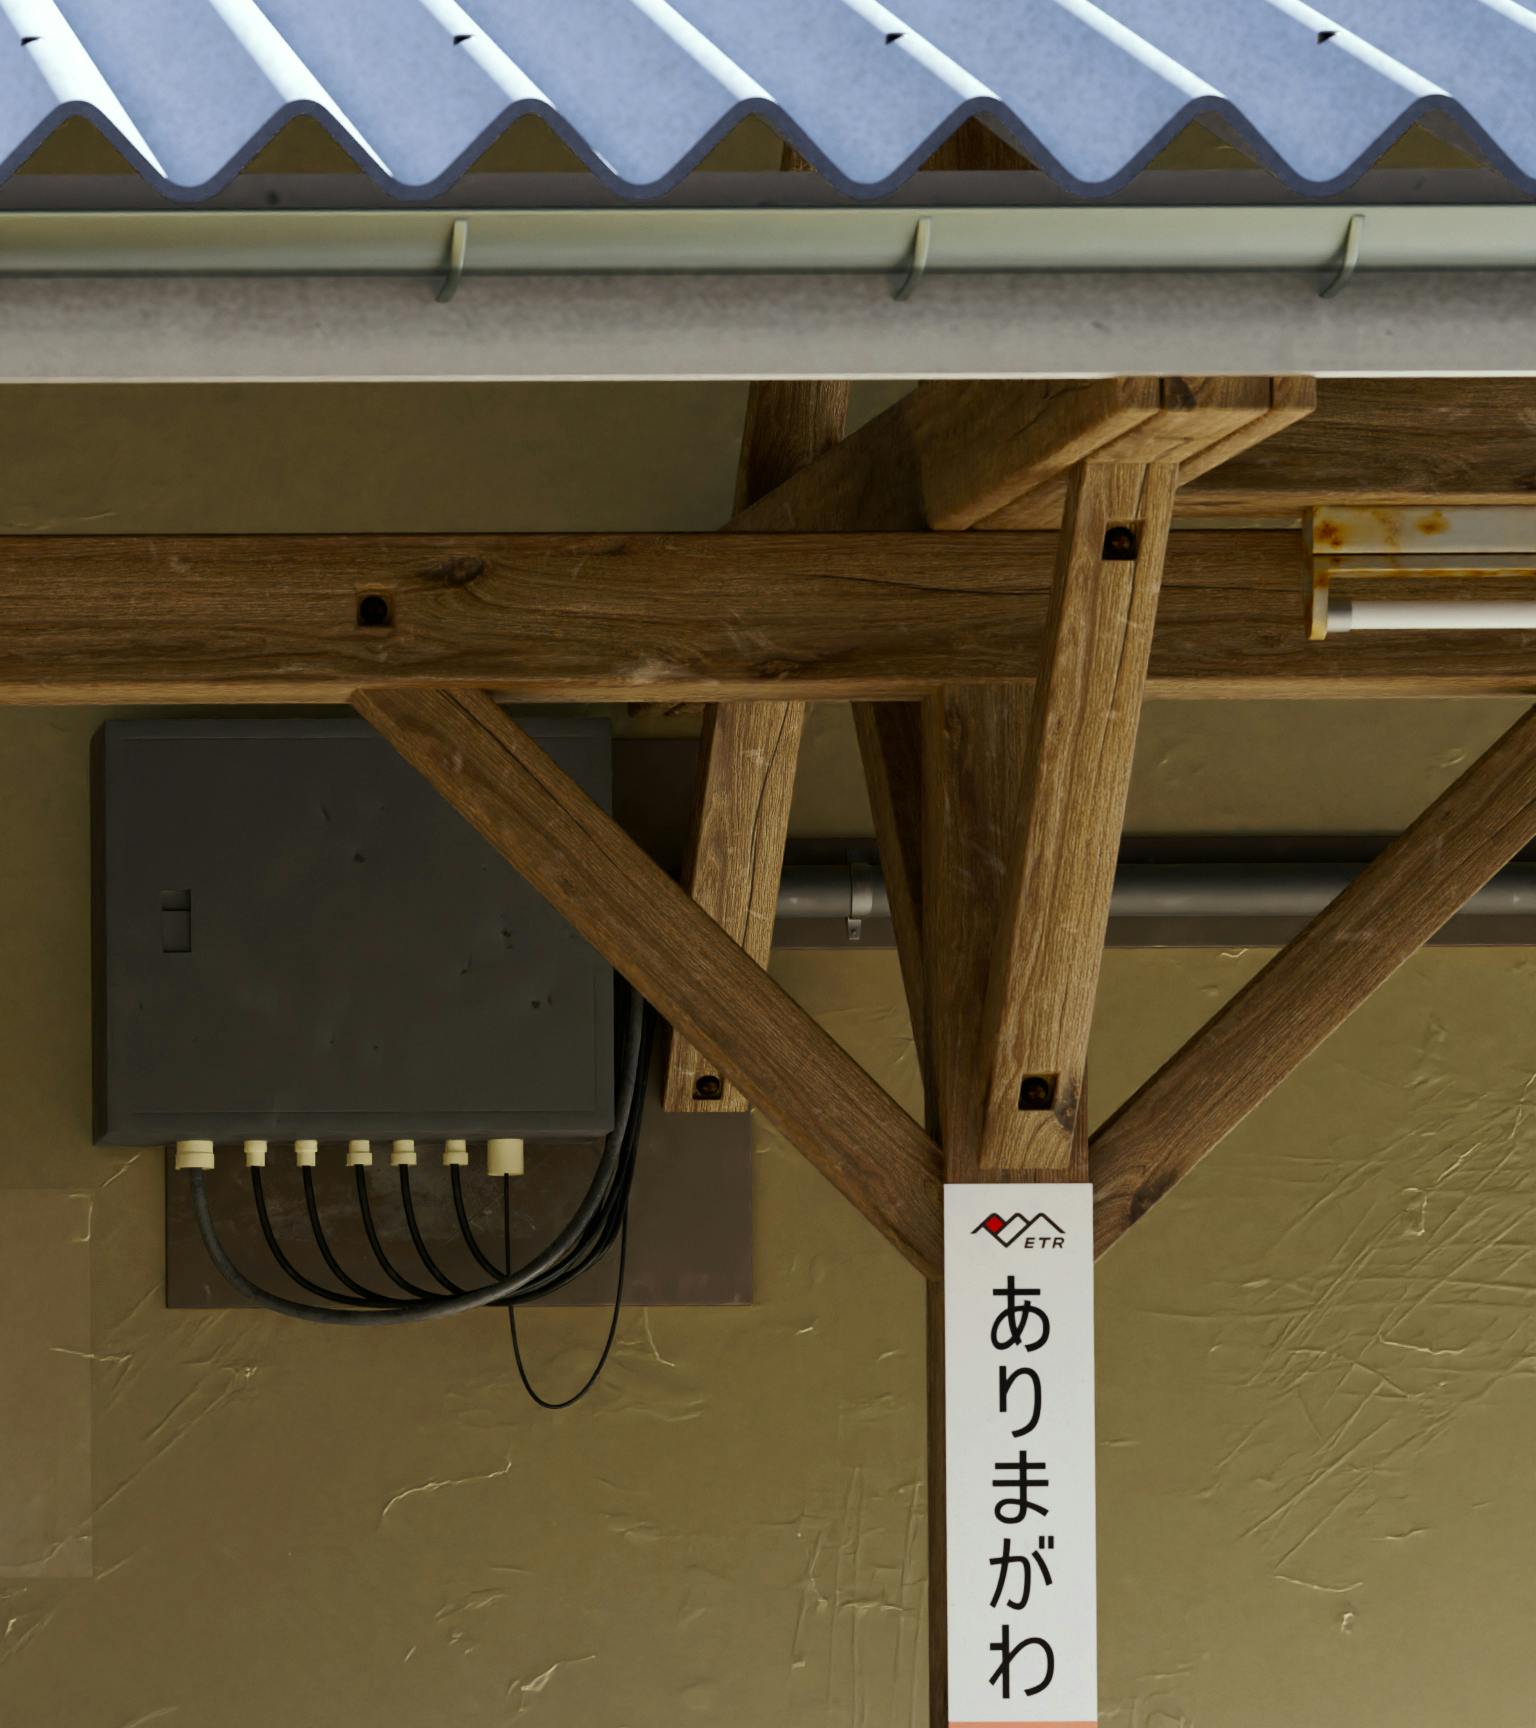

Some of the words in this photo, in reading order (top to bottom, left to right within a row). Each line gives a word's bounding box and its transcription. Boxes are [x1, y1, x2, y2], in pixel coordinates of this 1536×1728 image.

[1024, 1236, 1065, 1249] ETR
[988, 1274, 1056, 1700] ありまがわ
